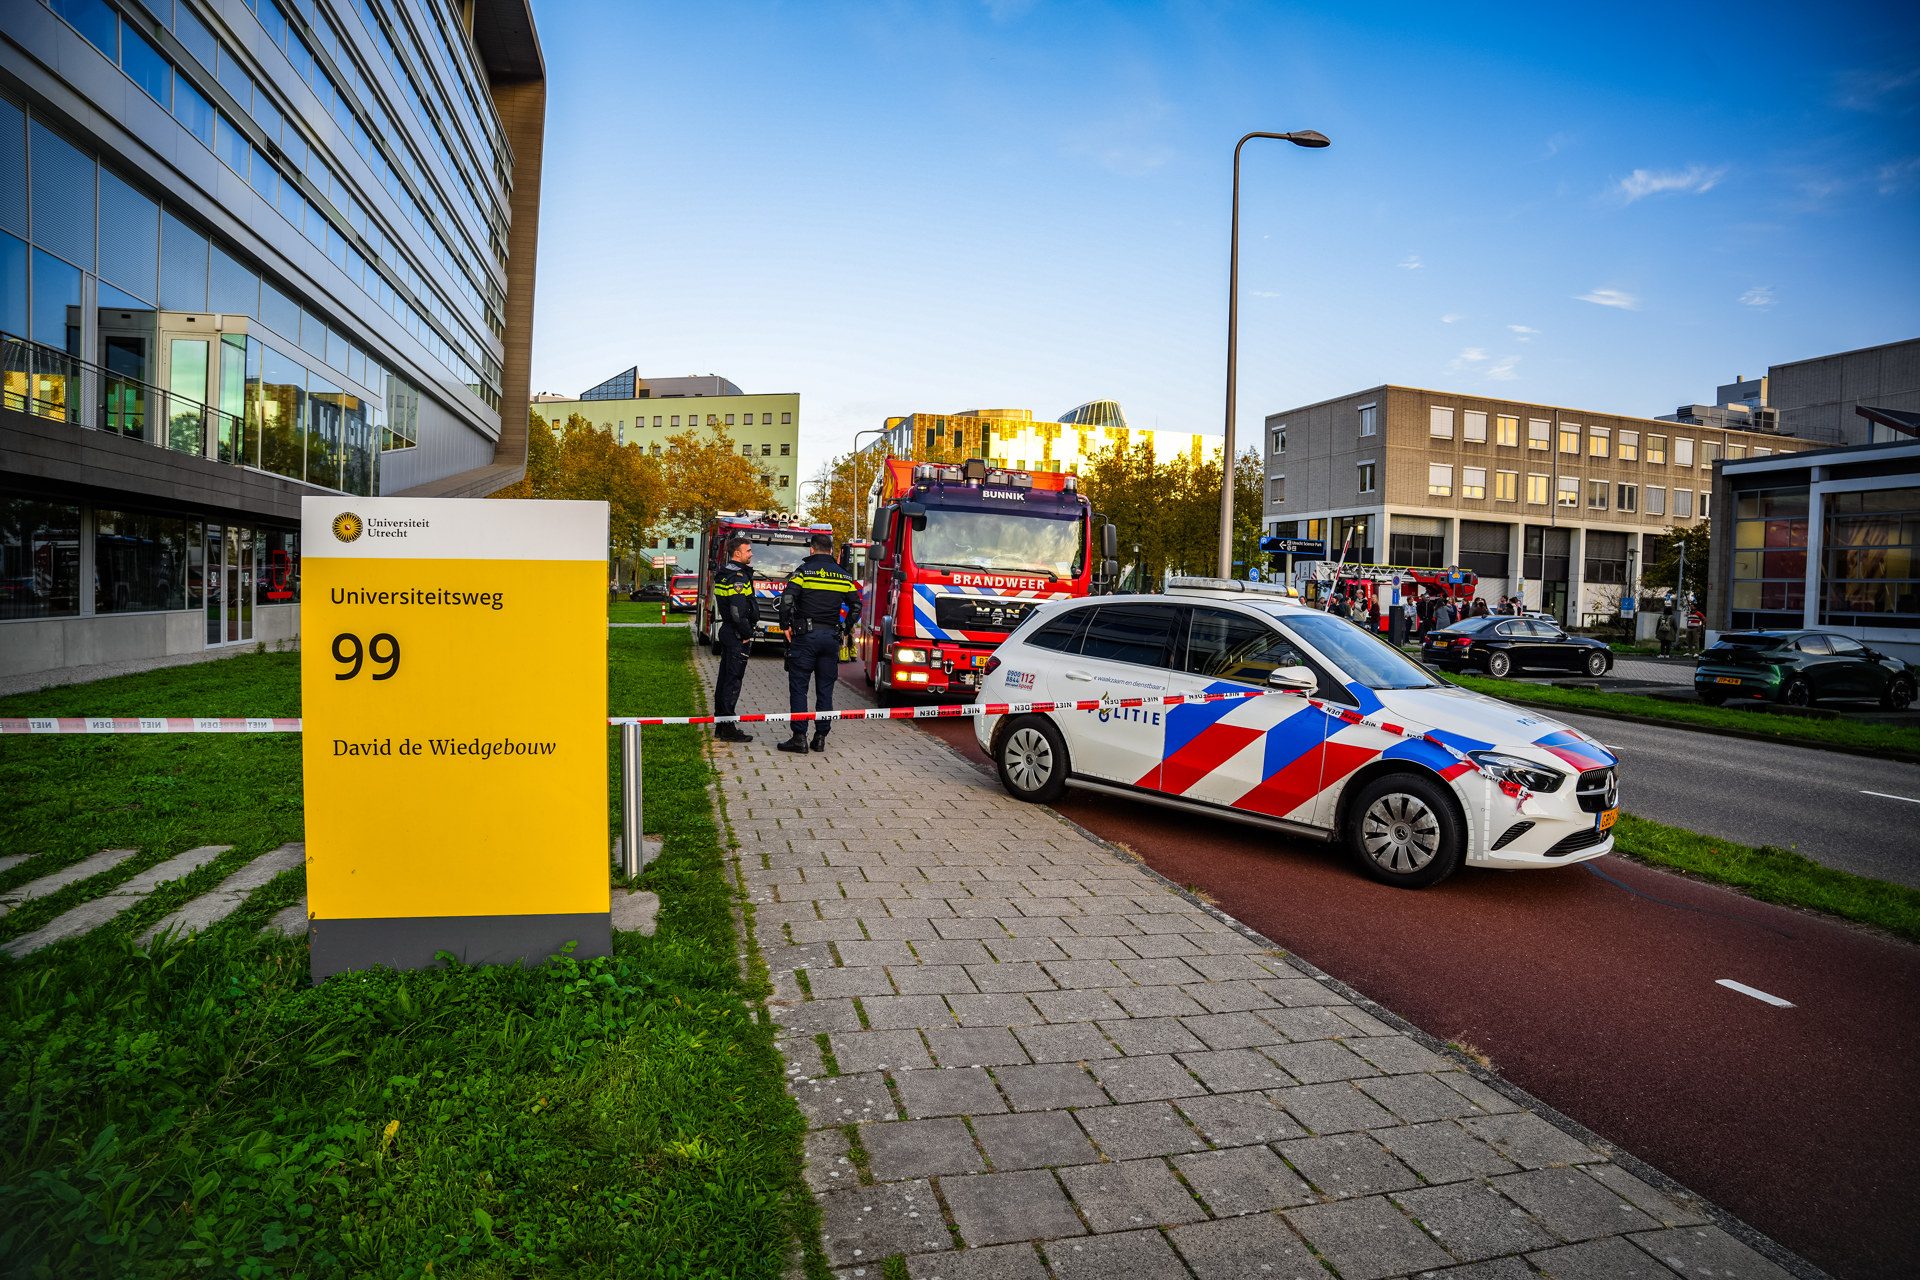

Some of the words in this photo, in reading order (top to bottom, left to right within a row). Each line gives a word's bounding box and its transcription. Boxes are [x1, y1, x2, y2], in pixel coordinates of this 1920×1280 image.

[982, 490, 1025, 500] BUNNIK
[367, 518, 430, 528] Universiteit
[367, 528, 408, 538] Utrecht
[755, 582, 787, 591] BRAND
[953, 574, 1046, 590] BRANDWEER
[331, 587, 504, 610] Universiteitsweg
[976, 606, 1020, 618] MAN
[331, 632, 401, 681] 99
[1021, 672, 1035, 684] 112
[1098, 676, 1125, 685] waakzaam
[1132, 681, 1161, 690] dienstbaar
[919, 709, 961, 717] BETREDEN
[962, 707, 980, 715] NIET
[1360, 719, 1376, 727] NIET
[333, 739, 392, 756] David
[399, 738, 423, 756] de
[429, 738, 557, 760] Wiedgebouw
